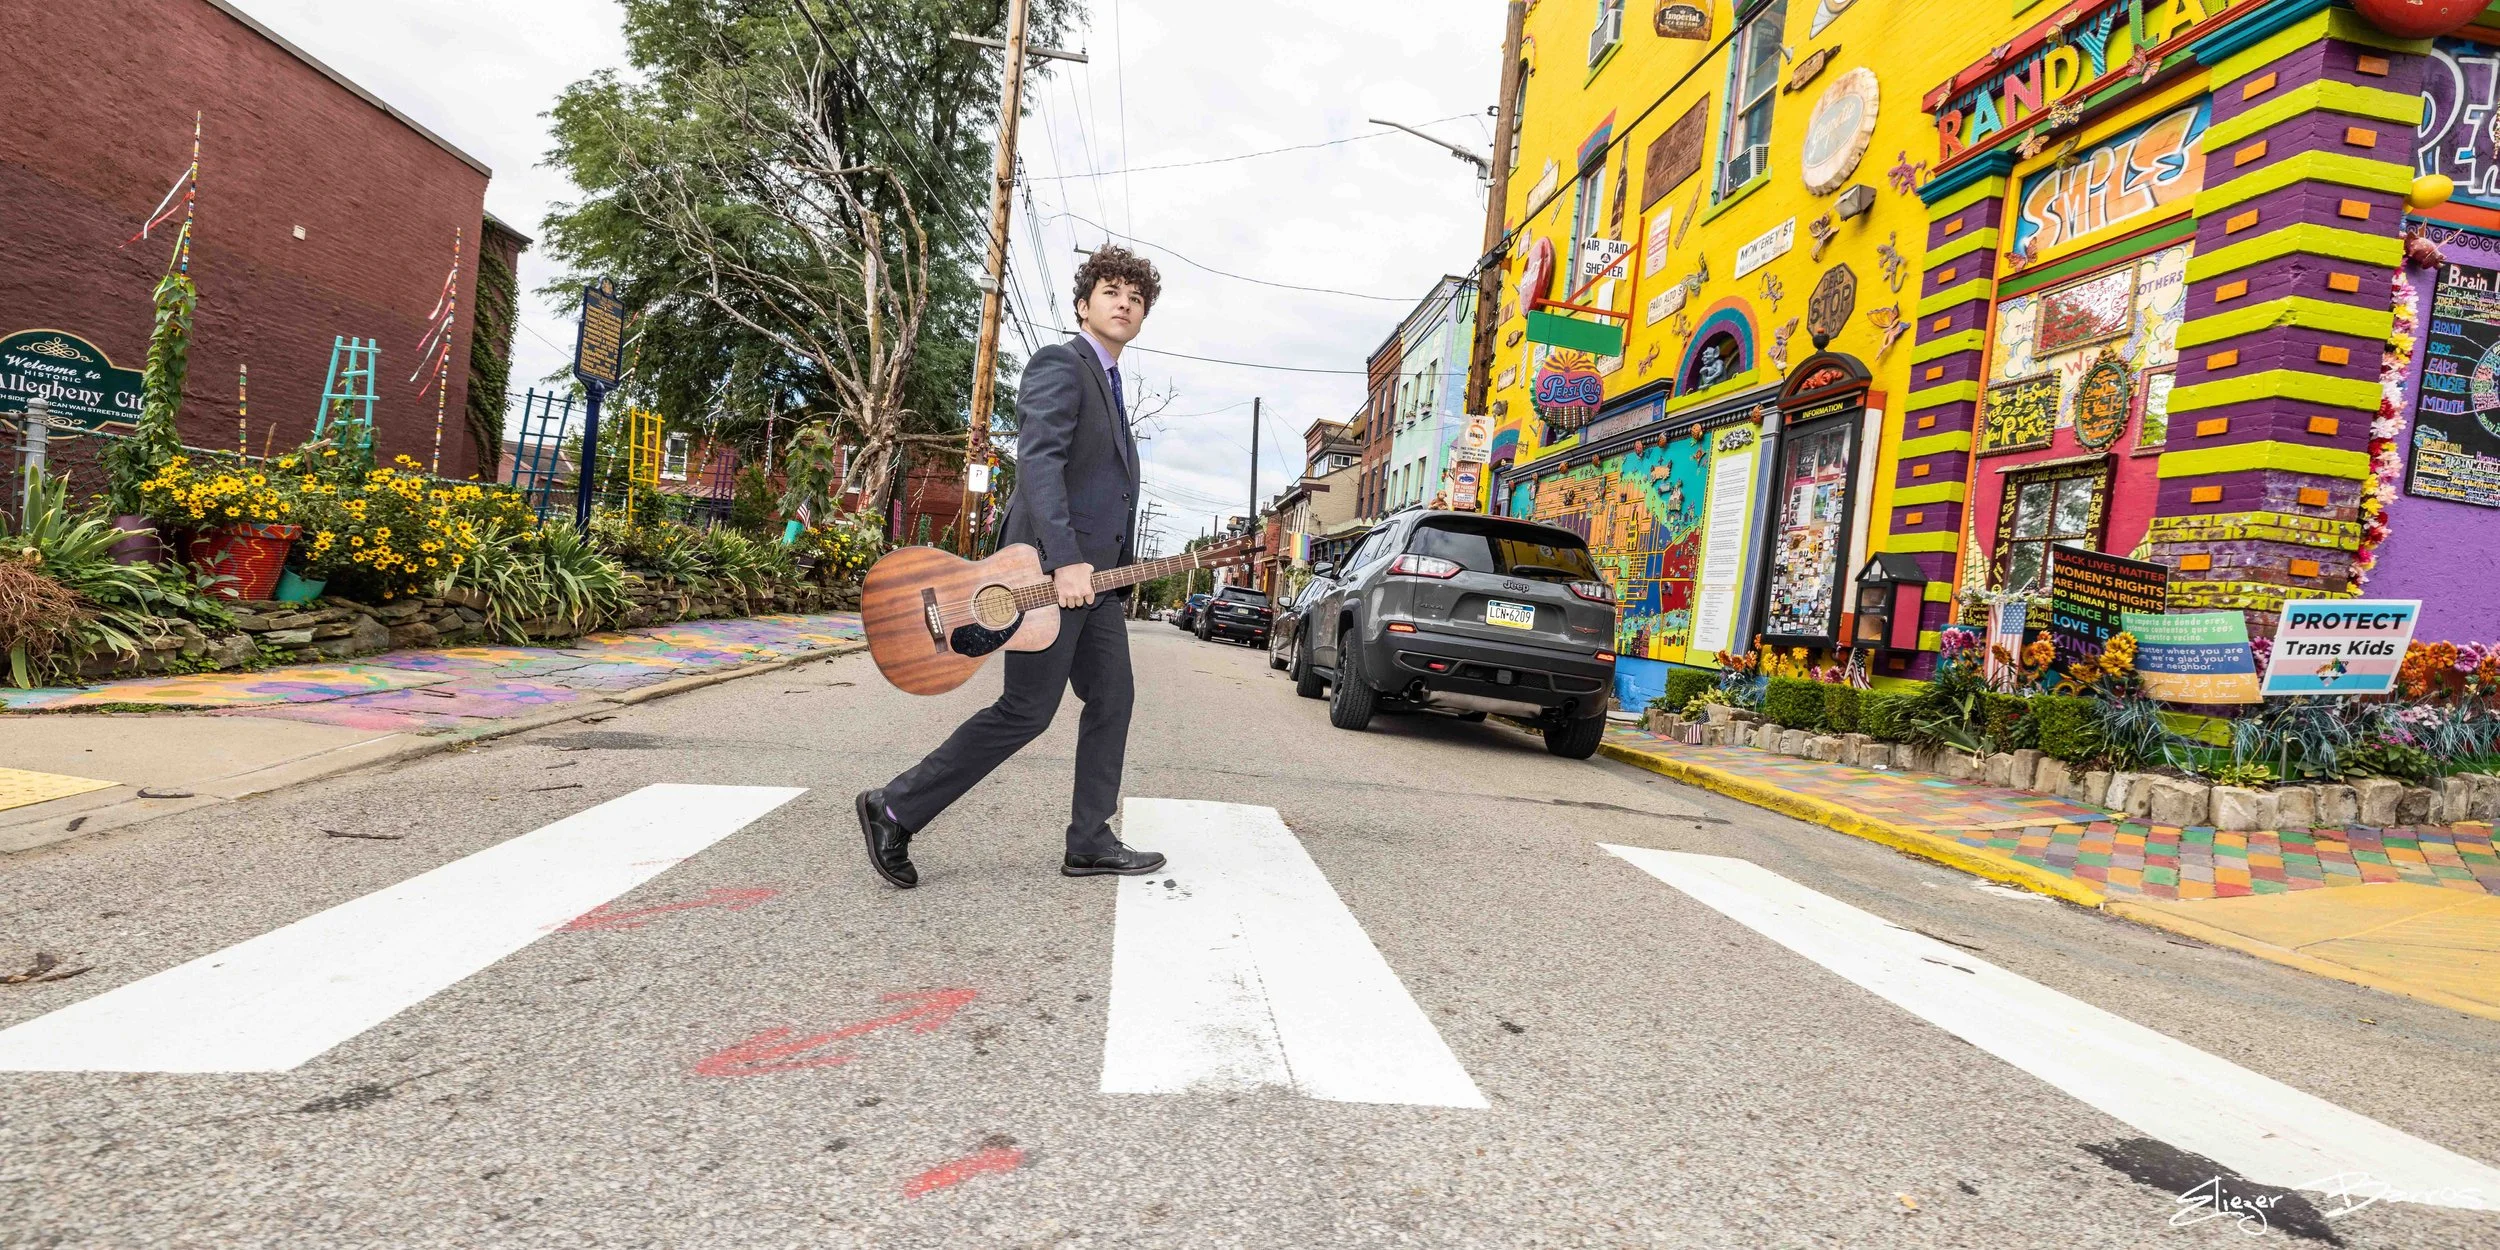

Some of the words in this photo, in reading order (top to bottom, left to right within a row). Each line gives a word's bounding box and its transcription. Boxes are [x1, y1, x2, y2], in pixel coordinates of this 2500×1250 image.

[1664, 10, 1701, 22] Imperial
[1586, 239, 1600, 252] AIR
[1608, 241, 1628, 255] RAID
[1740, 229, 1779, 261] MONTEREY
[1586, 262, 1623, 278] SHELTER
[2448, 264, 2488, 291] Brain
[2137, 269, 2184, 297] OTHERS
[1809, 283, 1852, 325] STOP
[2432, 320, 2462, 336] BRAIN
[2430, 341, 2451, 355] EYES
[5, 354, 78, 377] Welcome
[85, 369, 101, 379] to
[2428, 357, 2459, 375] EARS
[24, 369, 81, 384] HISTORIC
[2423, 373, 2466, 394] NOSE
[7, 395, 26, 403] SIDE
[115, 391, 144, 411] Cit
[2422, 394, 2465, 414] MOUTH
[69, 403, 87, 412] WAR
[87, 407, 121, 417] STREETS
[1802, 402, 1844, 419] INFORMATION
[2054, 551, 2085, 566] BLACK
[2087, 560, 2117, 573] LIVES
[2119, 566, 2166, 582] MATTER
[1502, 580, 1529, 593] Jeep
[2054, 563, 2113, 587] WOMEN'S
[2114, 578, 2165, 598] RIGHTS
[2053, 577, 2073, 590] ARE
[2074, 582, 2118, 601] HUMAN
[2119, 593, 2164, 611] RIGHTS
[2053, 588, 2068, 597] NO
[2070, 592, 2105, 608] HUMAN
[2109, 602, 2118, 611] IS
[2053, 599, 2102, 621] SCIENCE
[2108, 614, 2120, 626] IS
[2290, 612, 2407, 629] PROTECT
[2053, 613, 2089, 634] LOVE
[2096, 626, 2110, 639] IS
[2134, 618, 2159, 626] importa
[2162, 618, 2171, 626] de
[2151, 625, 2189, 634] contentos
[2191, 625, 2208, 634] que
[2212, 622, 2233, 632] seas
[2144, 633, 2170, 641] nuestro
[2166, 646, 2196, 655] where
[2199, 648, 2220, 659] you
[2224, 646, 2244, 654] are
[2286, 641, 2342, 655] Trans
[2346, 640, 2395, 656] Kids
[2166, 661, 2215, 672] neighbor.
[2177, 653, 2200, 664] glad
[2203, 653, 2240, 664] you're
